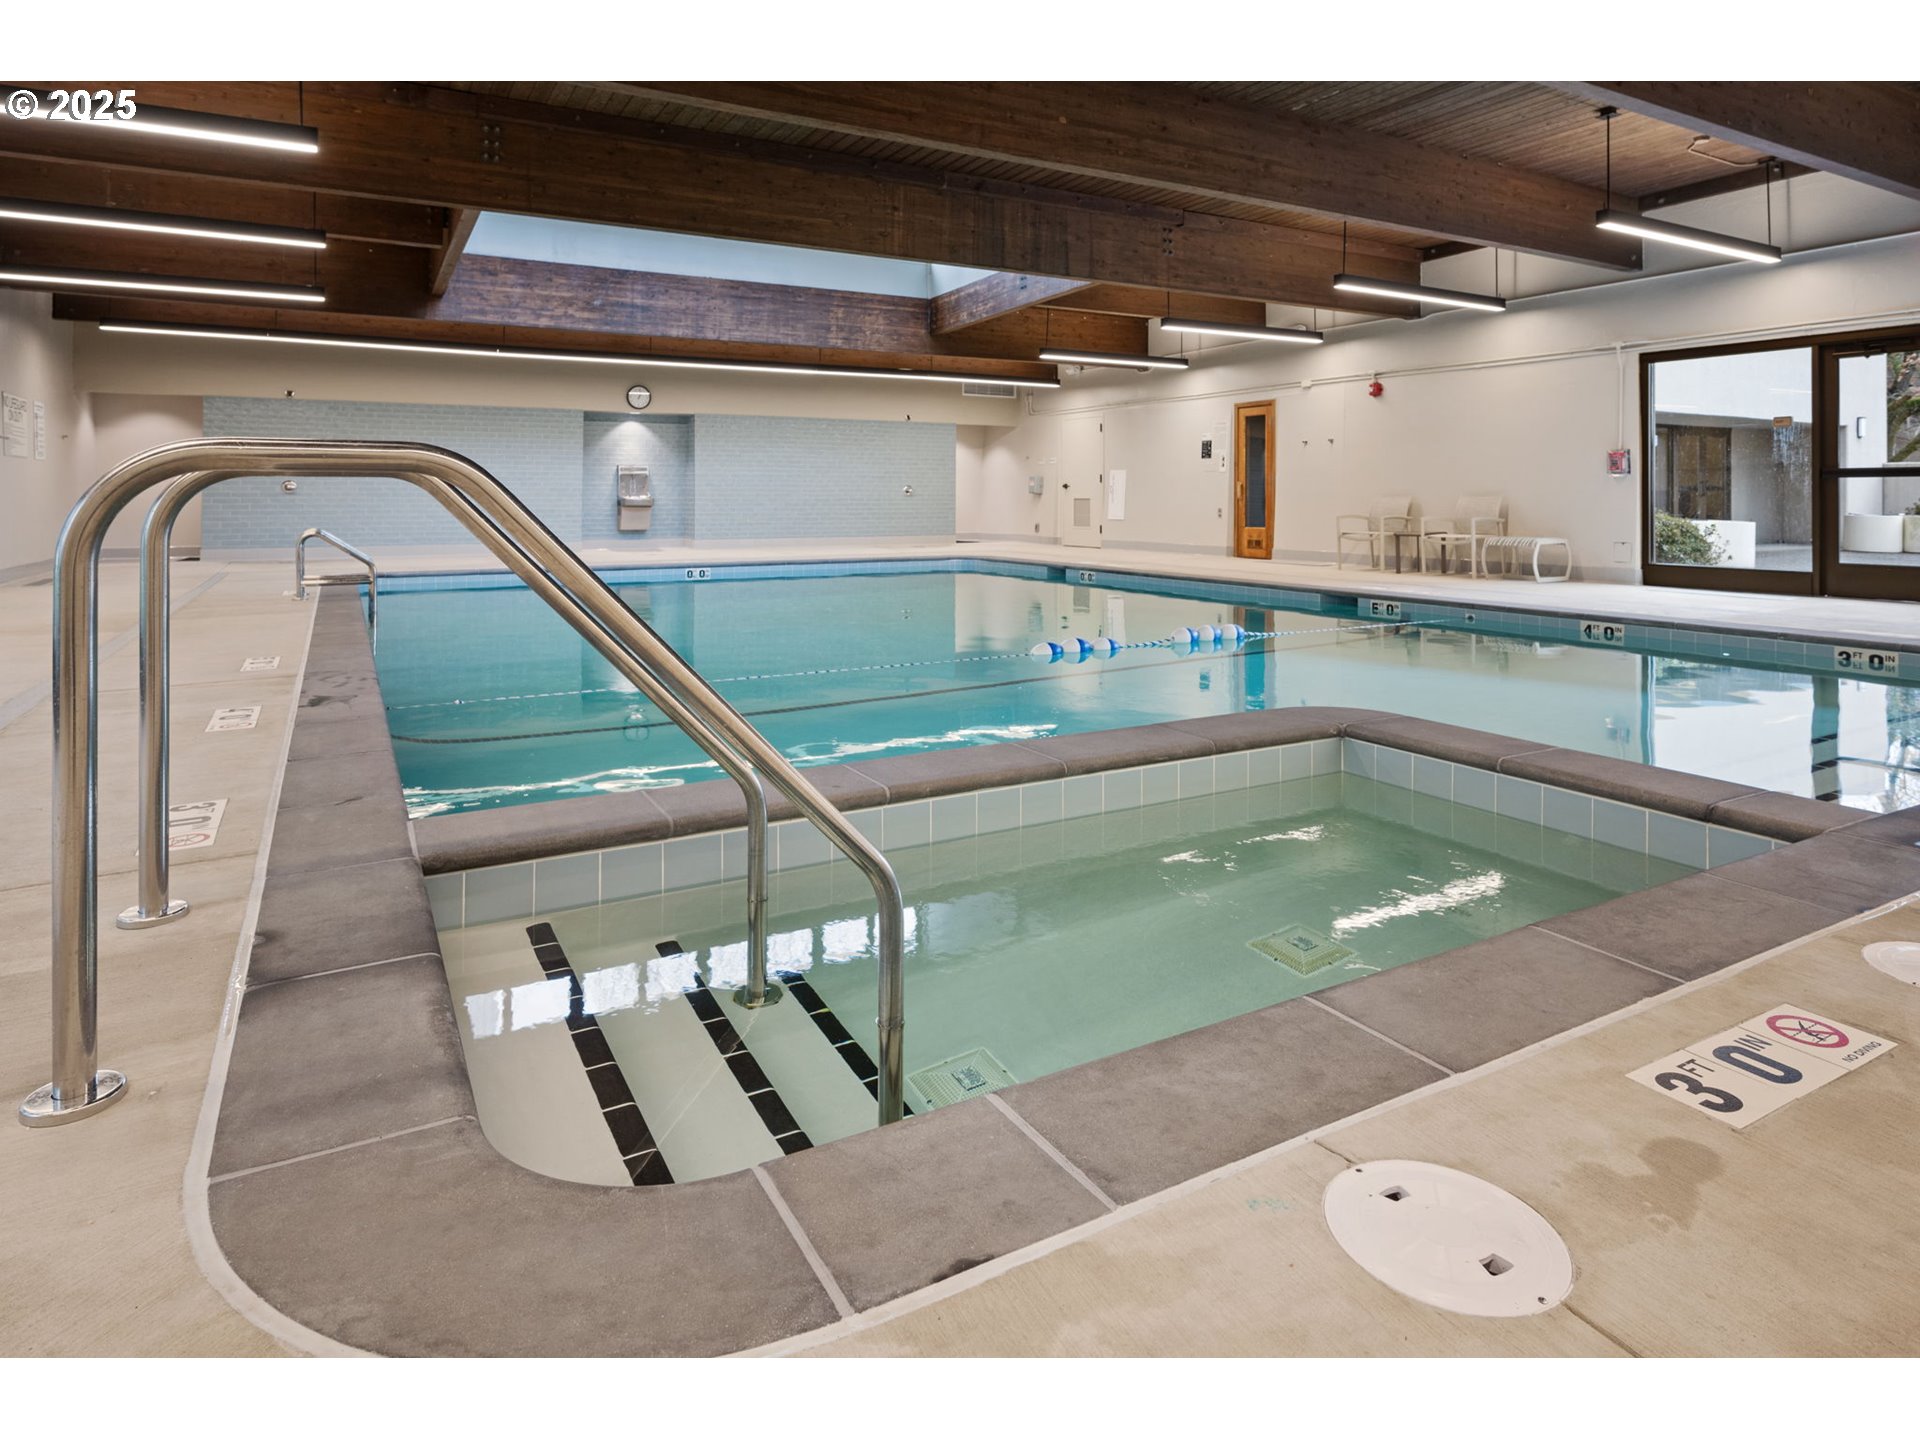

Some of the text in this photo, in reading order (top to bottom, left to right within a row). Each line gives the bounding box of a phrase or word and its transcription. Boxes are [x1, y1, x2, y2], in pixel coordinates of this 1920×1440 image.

[1838, 650, 1895, 671] 3 FT 0 IN
[1841, 1041, 1882, 1063] NO DIVING
[1654, 1034, 1803, 1113] 3 FT 0 IN
